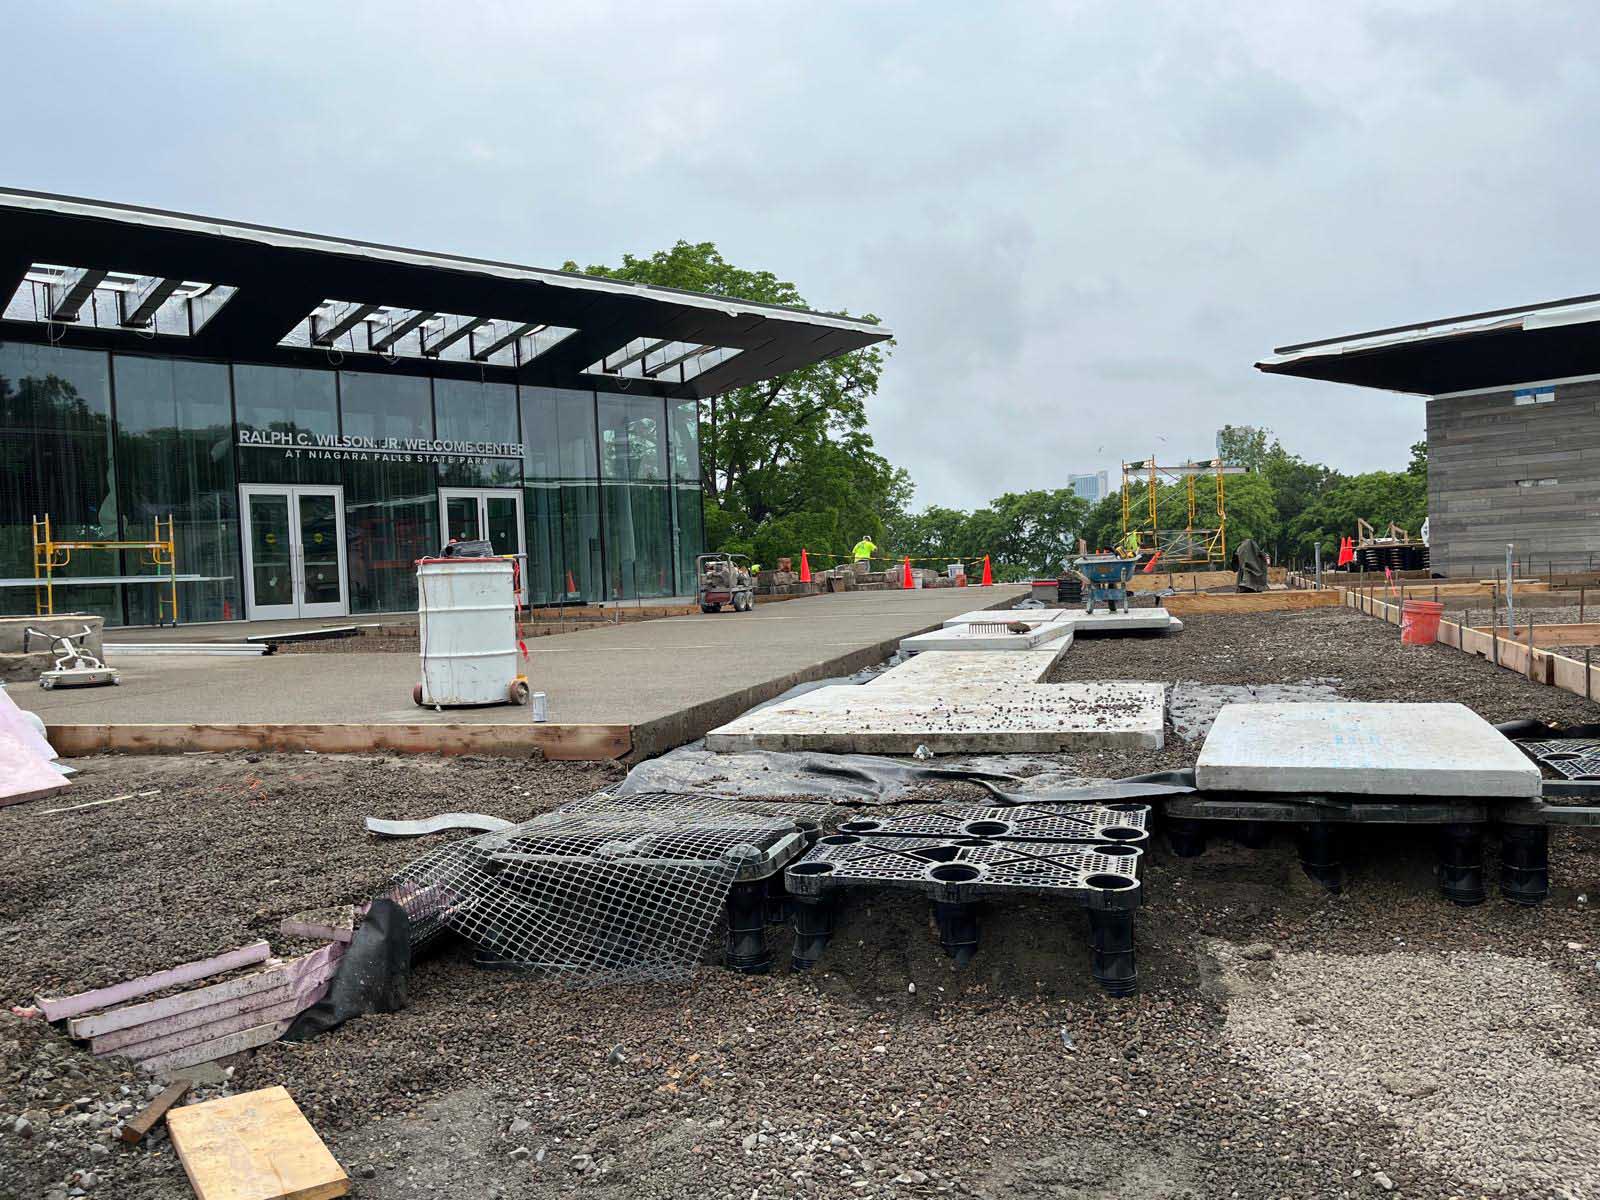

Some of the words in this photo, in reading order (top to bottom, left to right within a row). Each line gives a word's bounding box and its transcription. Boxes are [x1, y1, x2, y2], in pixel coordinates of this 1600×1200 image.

[239, 430, 293, 445] RALPH
[297, 433, 312, 446] C.
[381, 437, 401, 450] JR.
[405, 438, 473, 453] WELCOME
[477, 441, 525, 456] CENTER
[285, 449, 302, 458] AT
[309, 450, 368, 460] NIAGARA
[374, 453, 411, 462] FALLS
[417, 454, 454, 464] STATE
[459, 456, 489, 465] PARK
